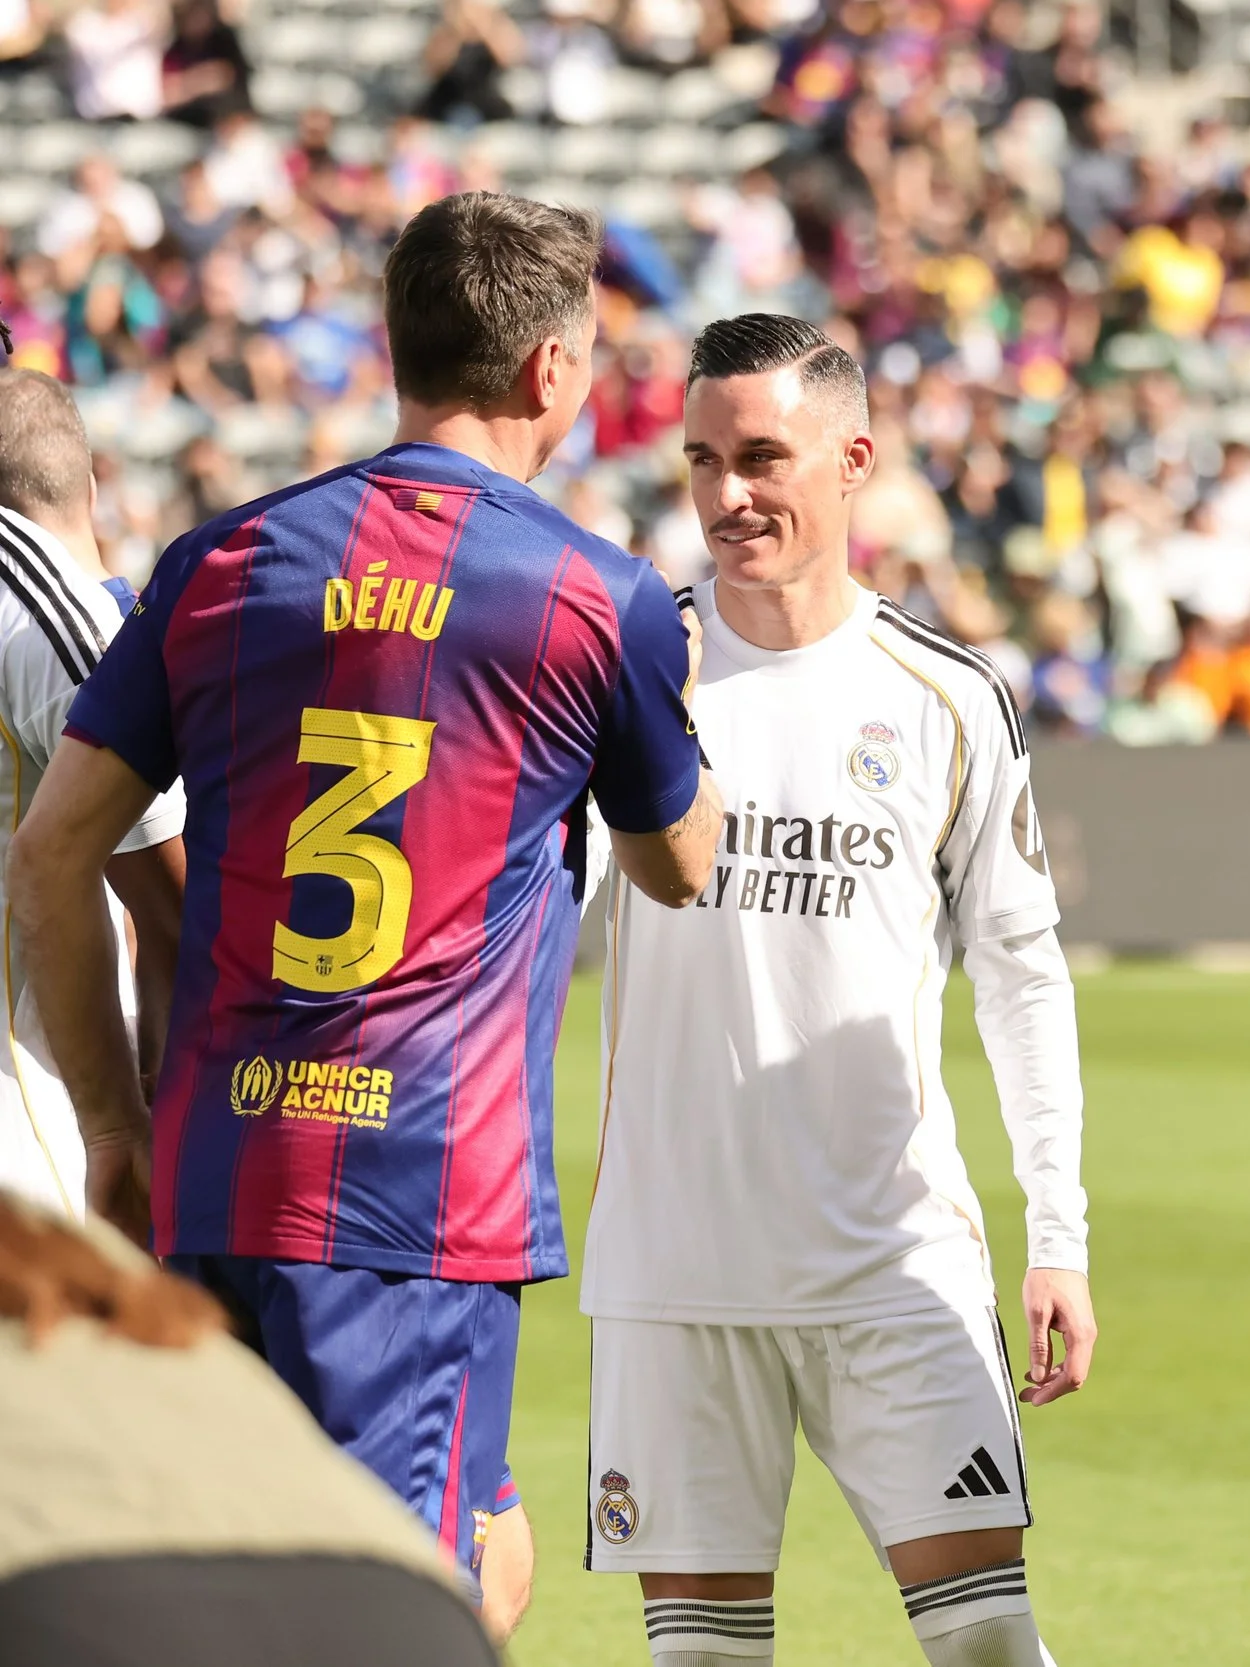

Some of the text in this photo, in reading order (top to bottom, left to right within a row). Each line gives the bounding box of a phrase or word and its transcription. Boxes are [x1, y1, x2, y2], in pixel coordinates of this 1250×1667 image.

[323, 559, 455, 641] DÉHU
[272, 707, 438, 993] 3
[715, 800, 895, 870] irates
[739, 868, 856, 918] BETTER
[281, 1085, 390, 1119] ACNUR
[287, 1060, 394, 1095] UNHCR
[281, 1109, 386, 1131] The UN Refugee Agency
